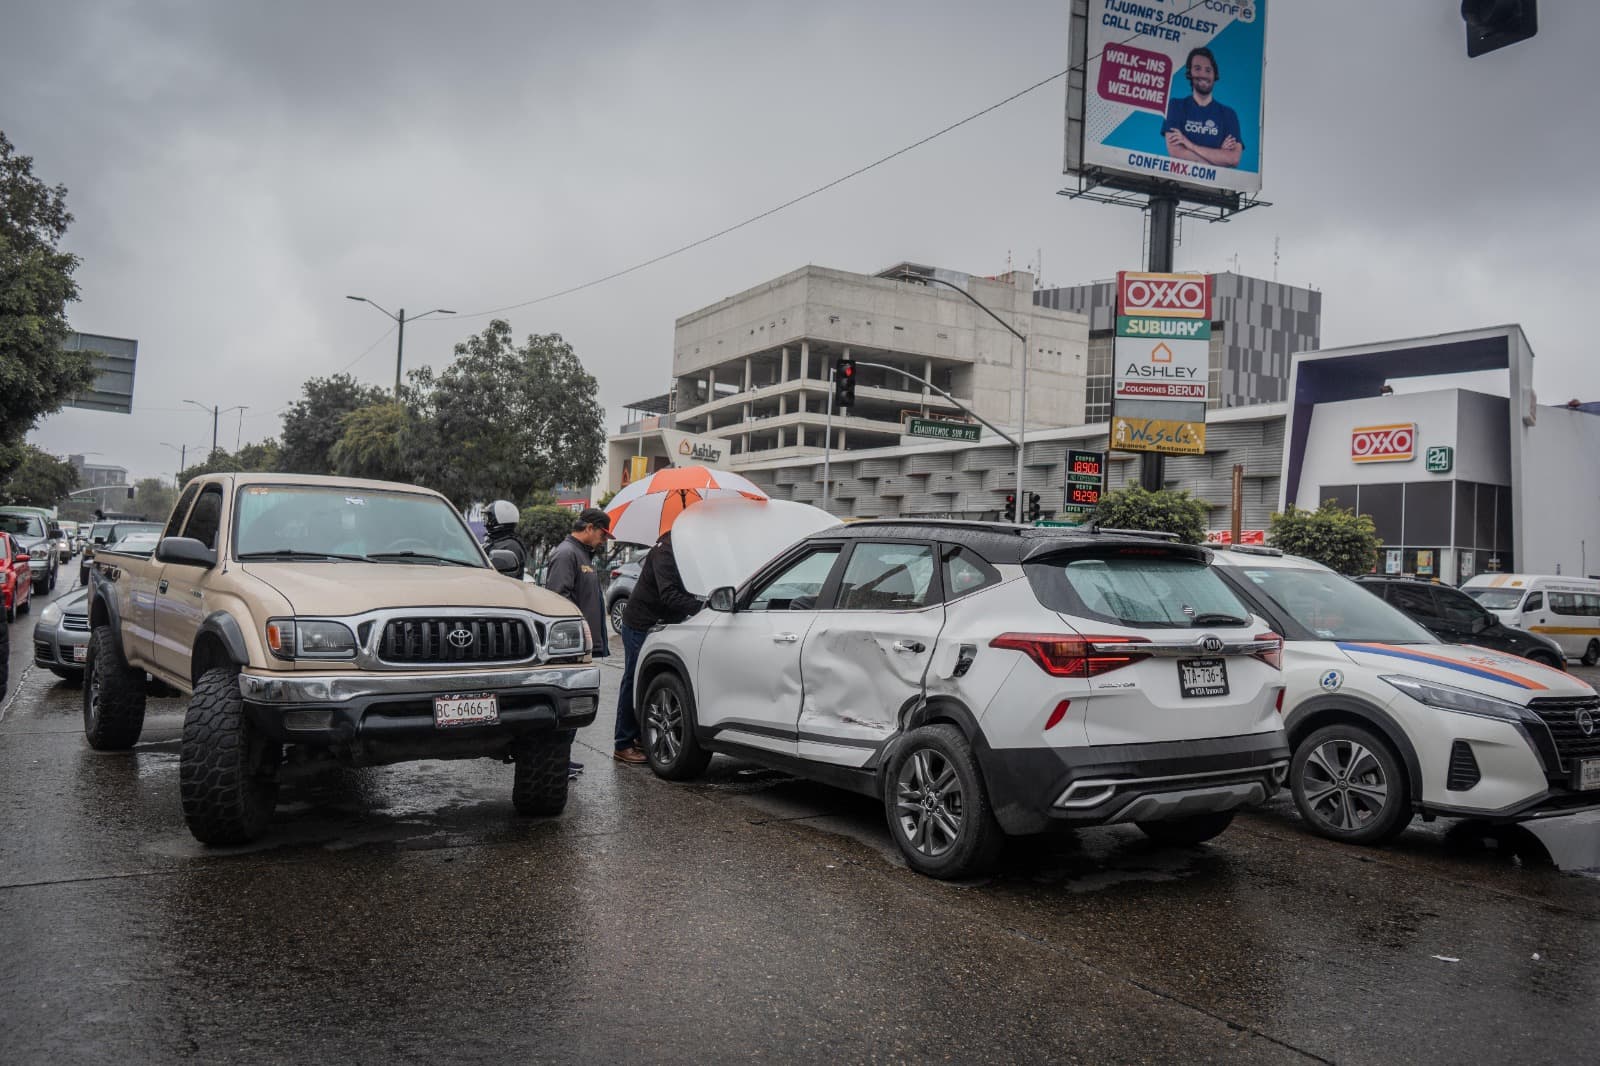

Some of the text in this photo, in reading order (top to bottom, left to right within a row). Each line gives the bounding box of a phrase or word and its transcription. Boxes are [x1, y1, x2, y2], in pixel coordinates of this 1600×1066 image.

[1102, 13, 1181, 42] CALL CENTER
[1167, 13, 1218, 34] COOLEST
[1106, 50, 1166, 74] WALK-INS
[1118, 68, 1165, 89] ALWAYS
[1108, 80, 1165, 104] WELCOME
[1128, 153, 1216, 181] CONFIEMX.COM
[1127, 281, 1203, 308] OXXO
[1125, 319, 1204, 336] SUBWAY
[1125, 363, 1198, 378] ASHLEY
[1125, 385, 1204, 396] COLCHONES BERUN
[692, 442, 721, 461] Ashley
[1353, 430, 1411, 455] OXXO
[1429, 448, 1446, 468] 24
